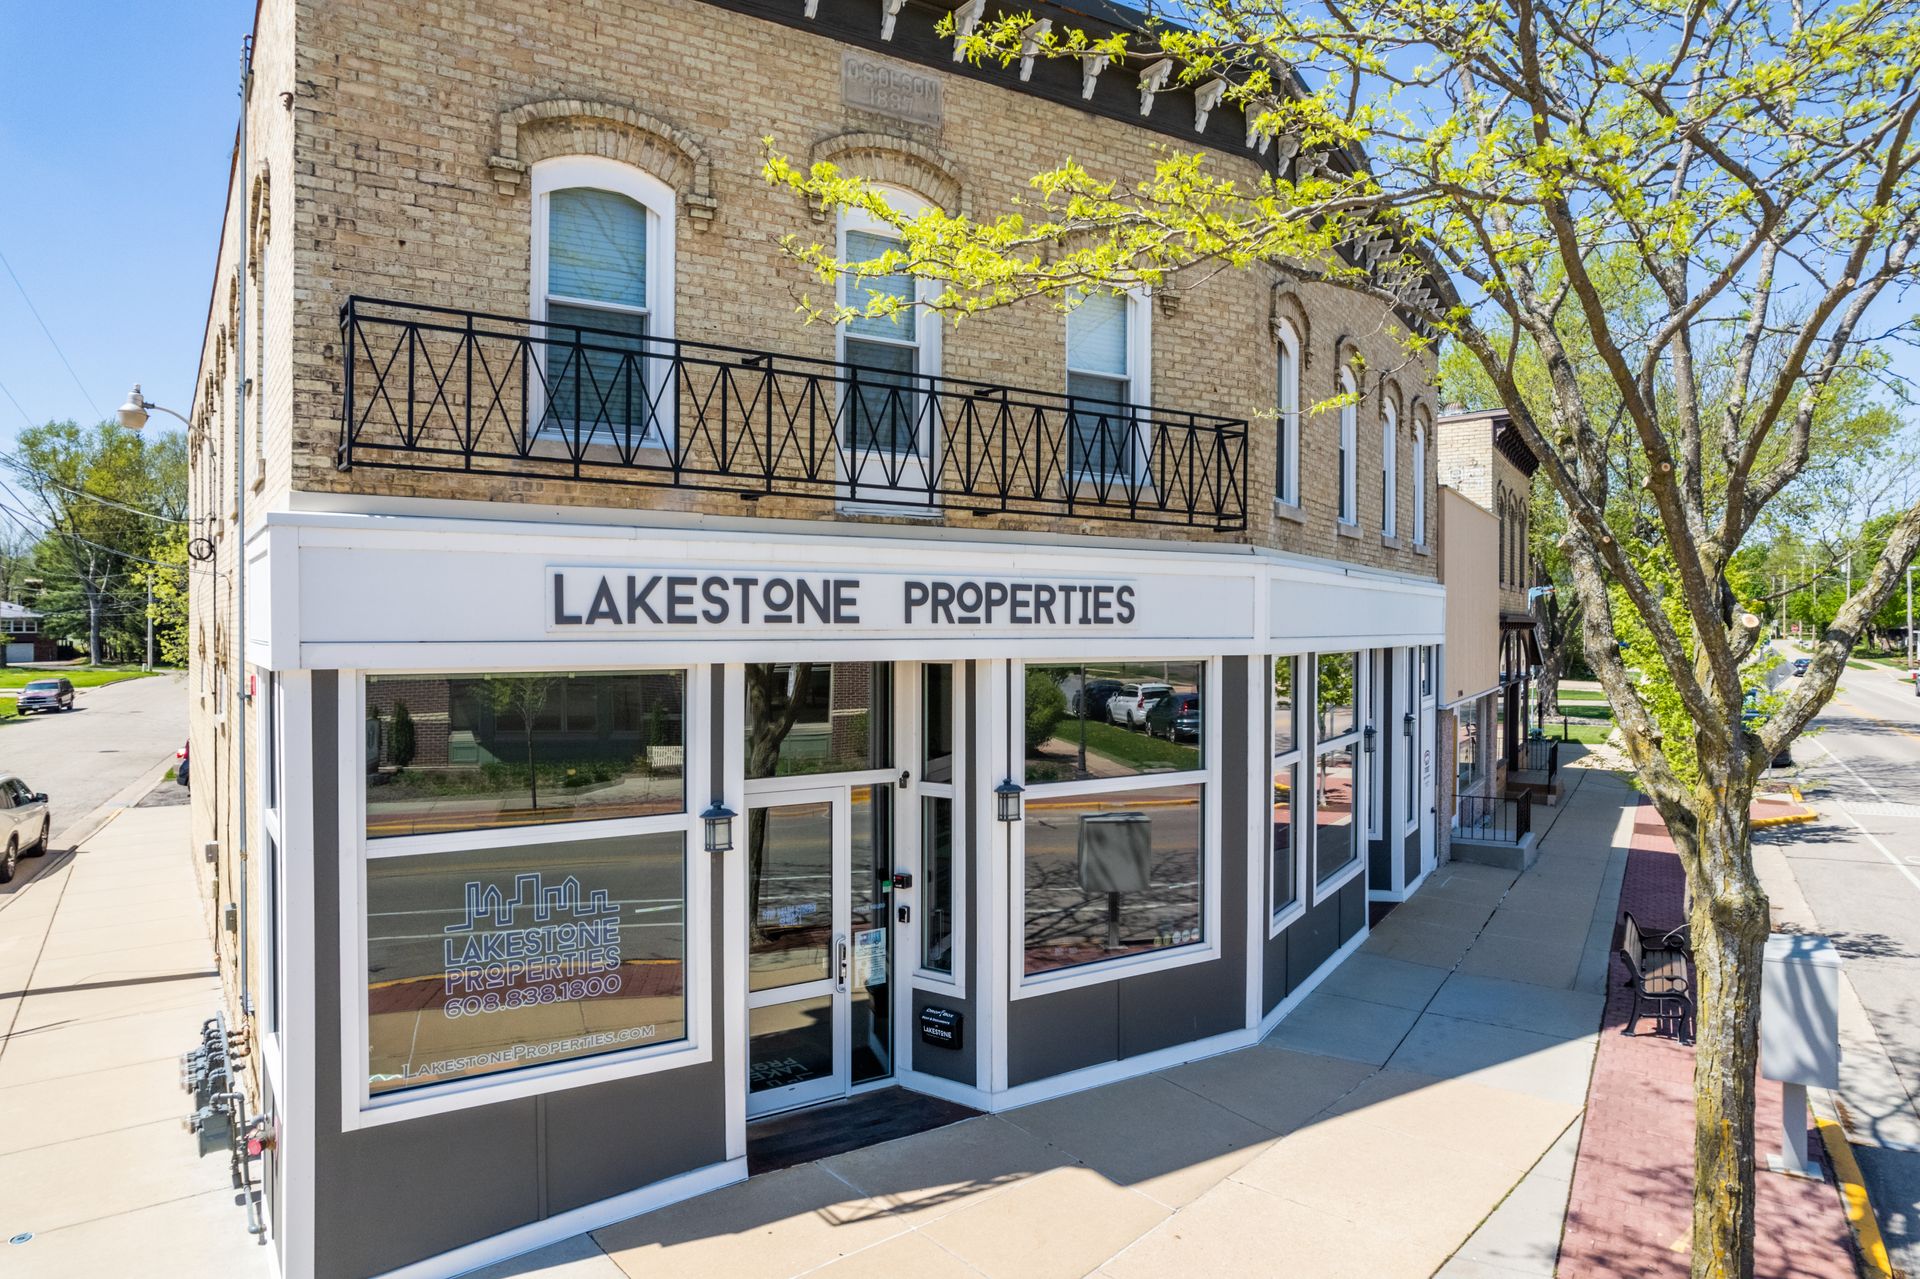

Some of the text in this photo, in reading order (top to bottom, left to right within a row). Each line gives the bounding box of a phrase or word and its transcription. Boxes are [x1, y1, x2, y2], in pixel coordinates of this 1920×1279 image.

[554, 573, 1135, 625] LAKESTONE PROPERTIES
[444, 916, 621, 967] LAKESTONE
[444, 946, 621, 995] PROPERTIES
[444, 974, 622, 1019] 608.838.1800
